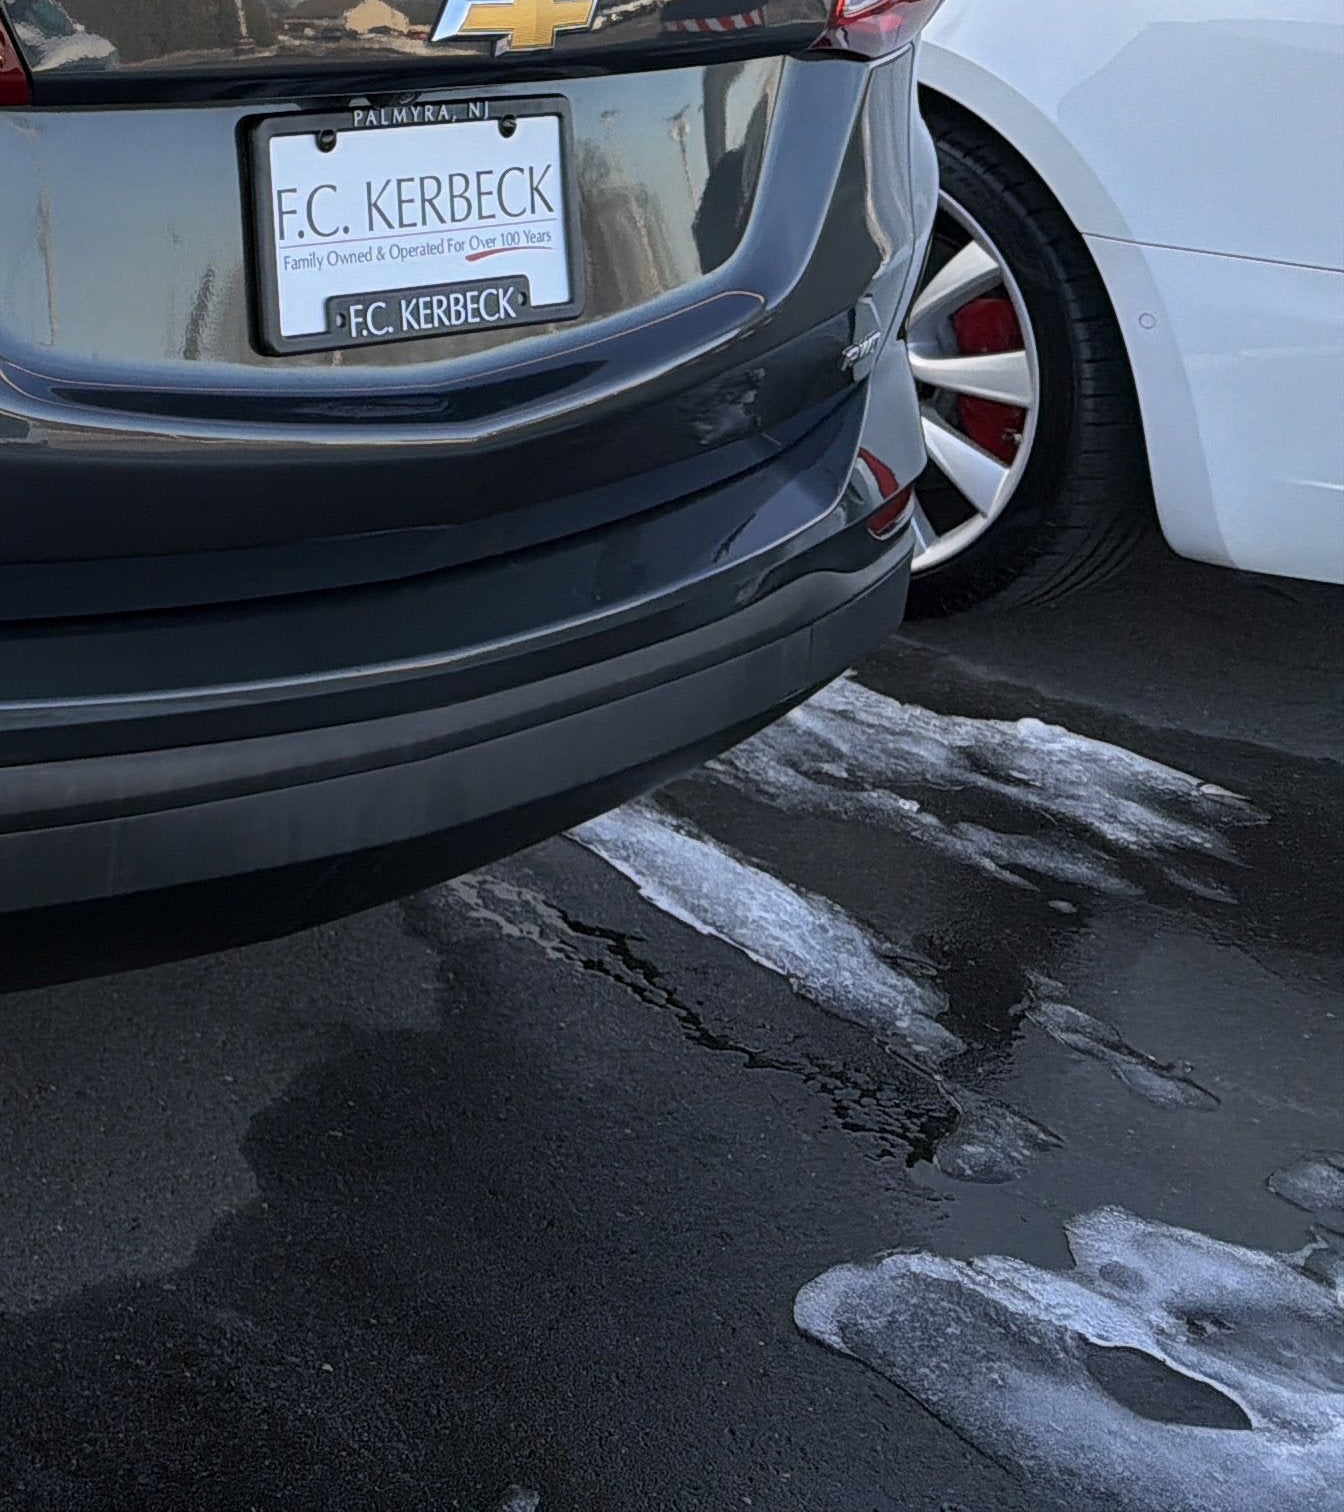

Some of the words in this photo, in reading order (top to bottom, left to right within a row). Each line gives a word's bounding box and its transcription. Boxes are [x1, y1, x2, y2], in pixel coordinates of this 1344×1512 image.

[353, 104, 457, 127] PALMYRA,
[468, 101, 489, 120] NJ
[277, 184, 350, 240] F.C.
[366, 164, 555, 232] KERBECK
[283, 252, 324, 271] Family
[327, 245, 373, 266] Owned
[376, 246, 385, 261] &
[389, 239, 445, 262] Operated
[447, 238, 465, 253] For
[469, 235, 496, 251] Over
[500, 231, 521, 247] 100
[523, 229, 552, 244] Years
[349, 301, 393, 338] F.C.
[400, 286, 517, 332] KERBECK
